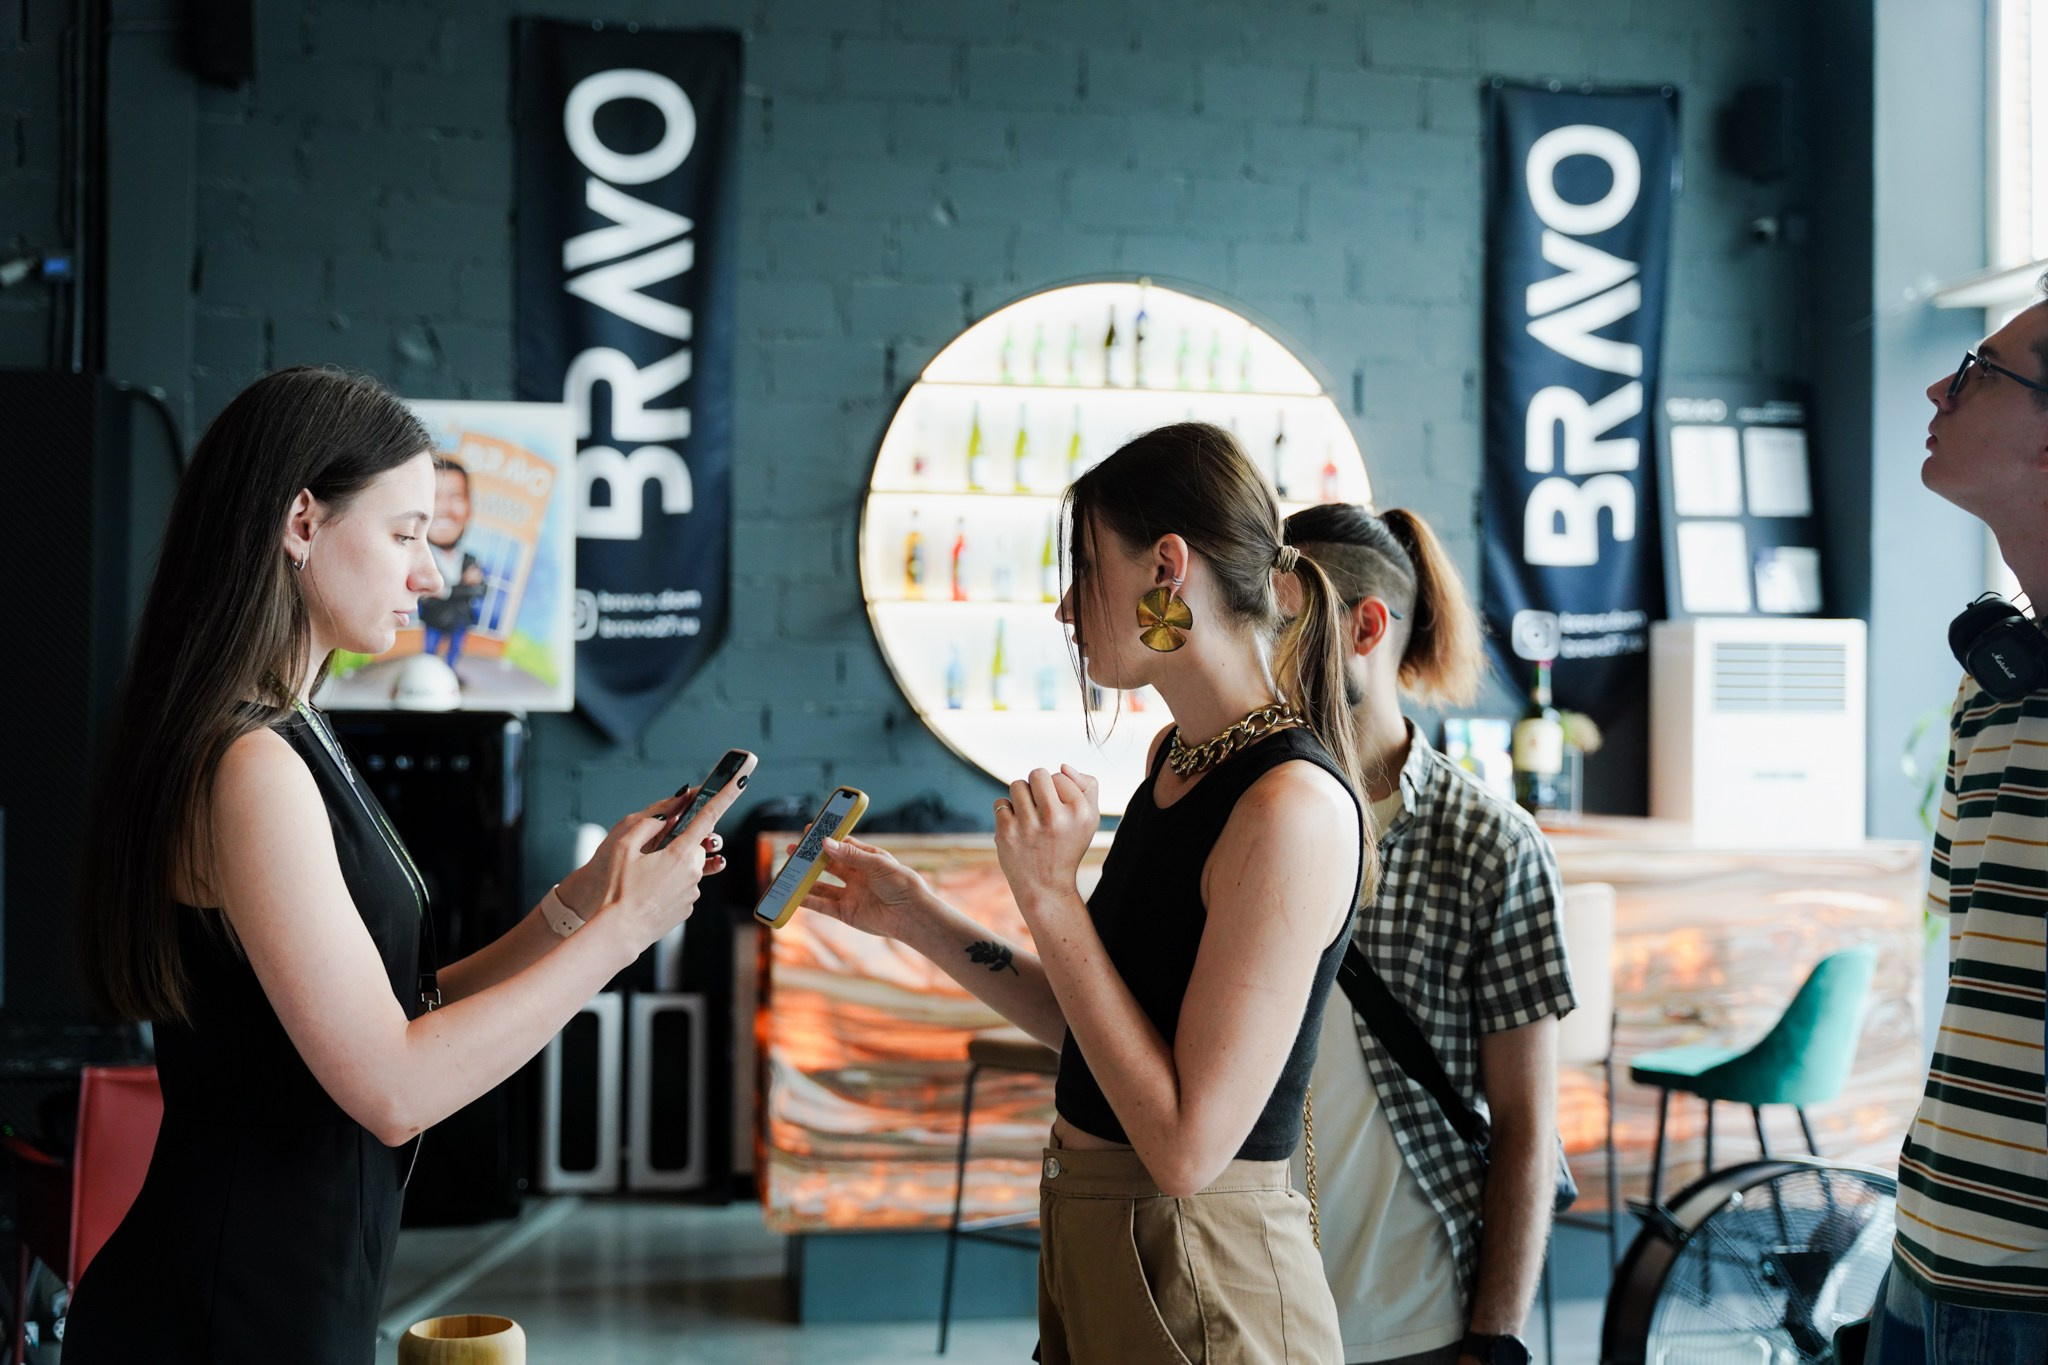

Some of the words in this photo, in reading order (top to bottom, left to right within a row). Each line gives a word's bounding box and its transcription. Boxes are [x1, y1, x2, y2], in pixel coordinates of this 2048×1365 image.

[563, 68, 697, 540] BRAVO
[1524, 124, 1643, 567] BRAVO
[461, 442, 553, 497] BRAVO
[1991, 652, 2017, 680] Marshall
[310, 719, 333, 753] Week
